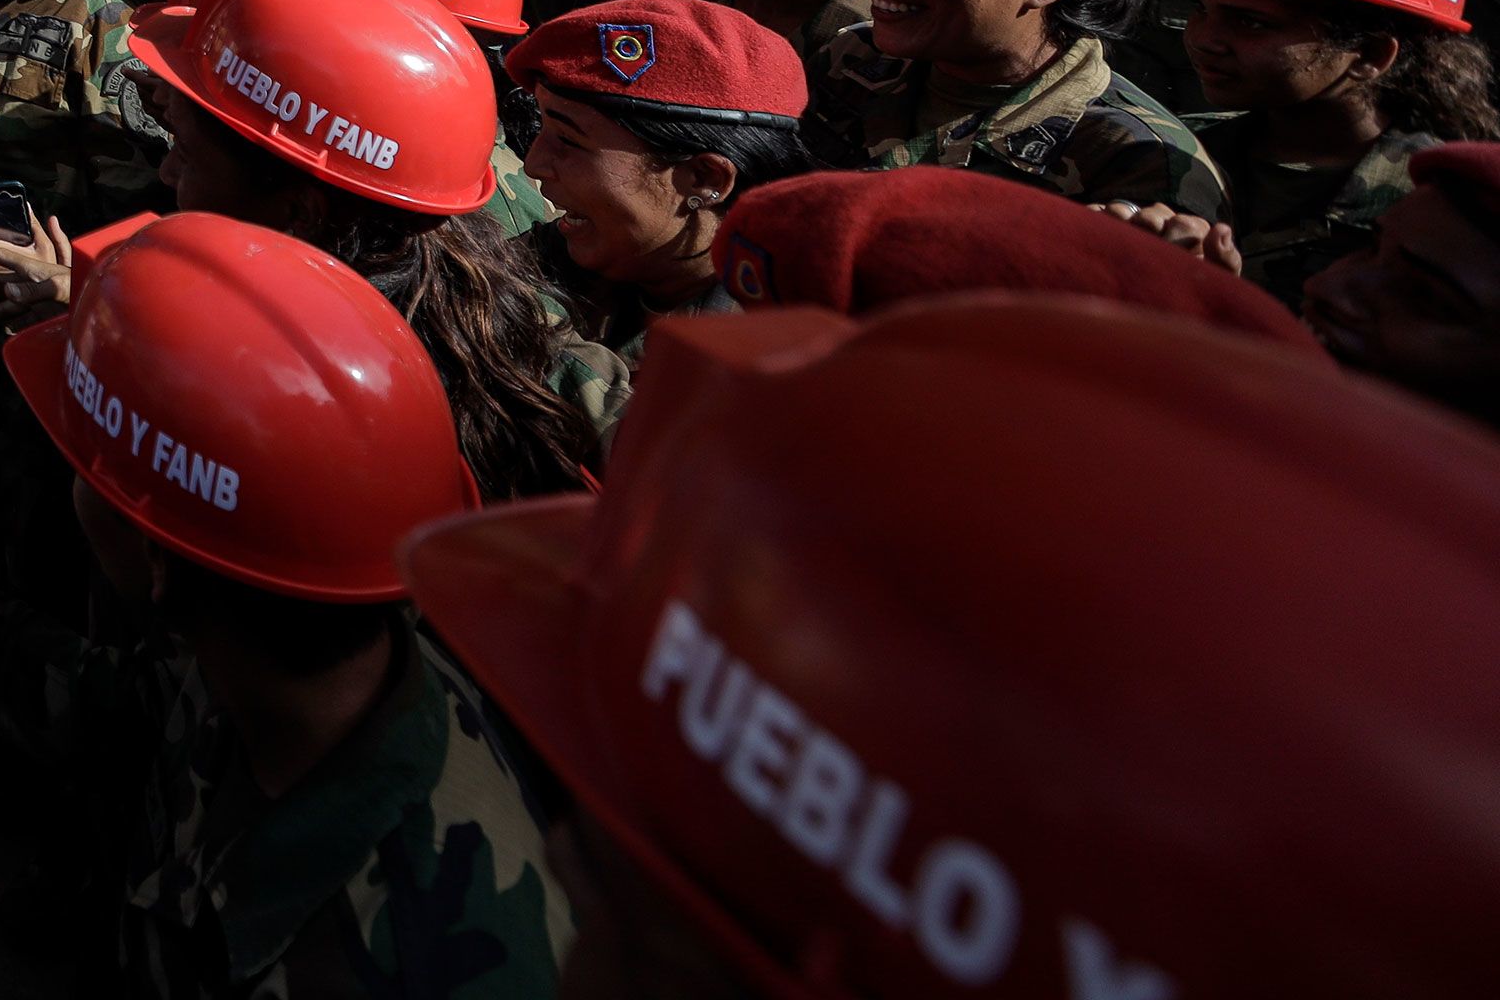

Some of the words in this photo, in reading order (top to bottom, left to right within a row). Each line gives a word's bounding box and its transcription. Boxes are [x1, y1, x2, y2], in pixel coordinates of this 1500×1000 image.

[215, 46, 302, 122] PUEBLO
[304, 101, 329, 135] Y
[324, 115, 400, 170] FANB
[64, 338, 124, 439] PUEBLO
[130, 410, 150, 457] Y
[152, 430, 240, 512] FANB
[638, 597, 1023, 988] PUEBLO
